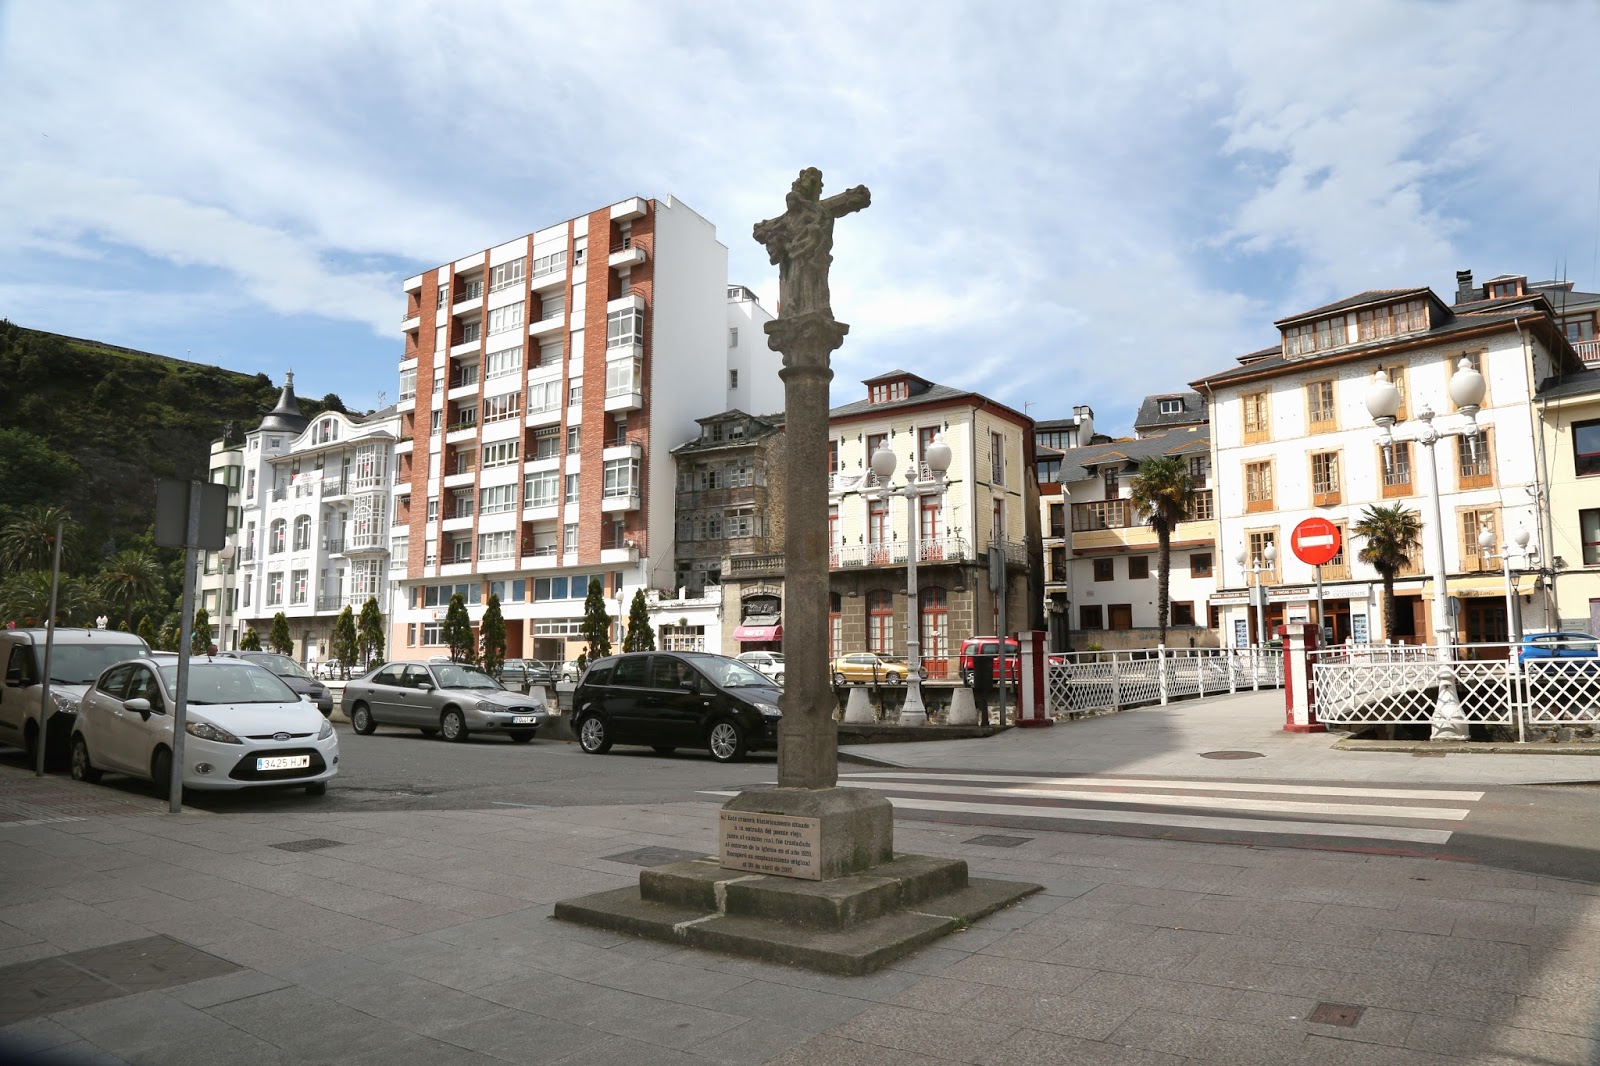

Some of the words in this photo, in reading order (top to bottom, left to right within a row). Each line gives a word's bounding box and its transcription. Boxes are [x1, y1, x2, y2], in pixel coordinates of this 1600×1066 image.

[1333, 590, 1366, 598] OCCIDENTE
[264, 758, 288, 769] 3425
[784, 839, 811, 847] trasladado
[754, 854, 790, 864] emplazamiento
[790, 858, 811, 866] original
